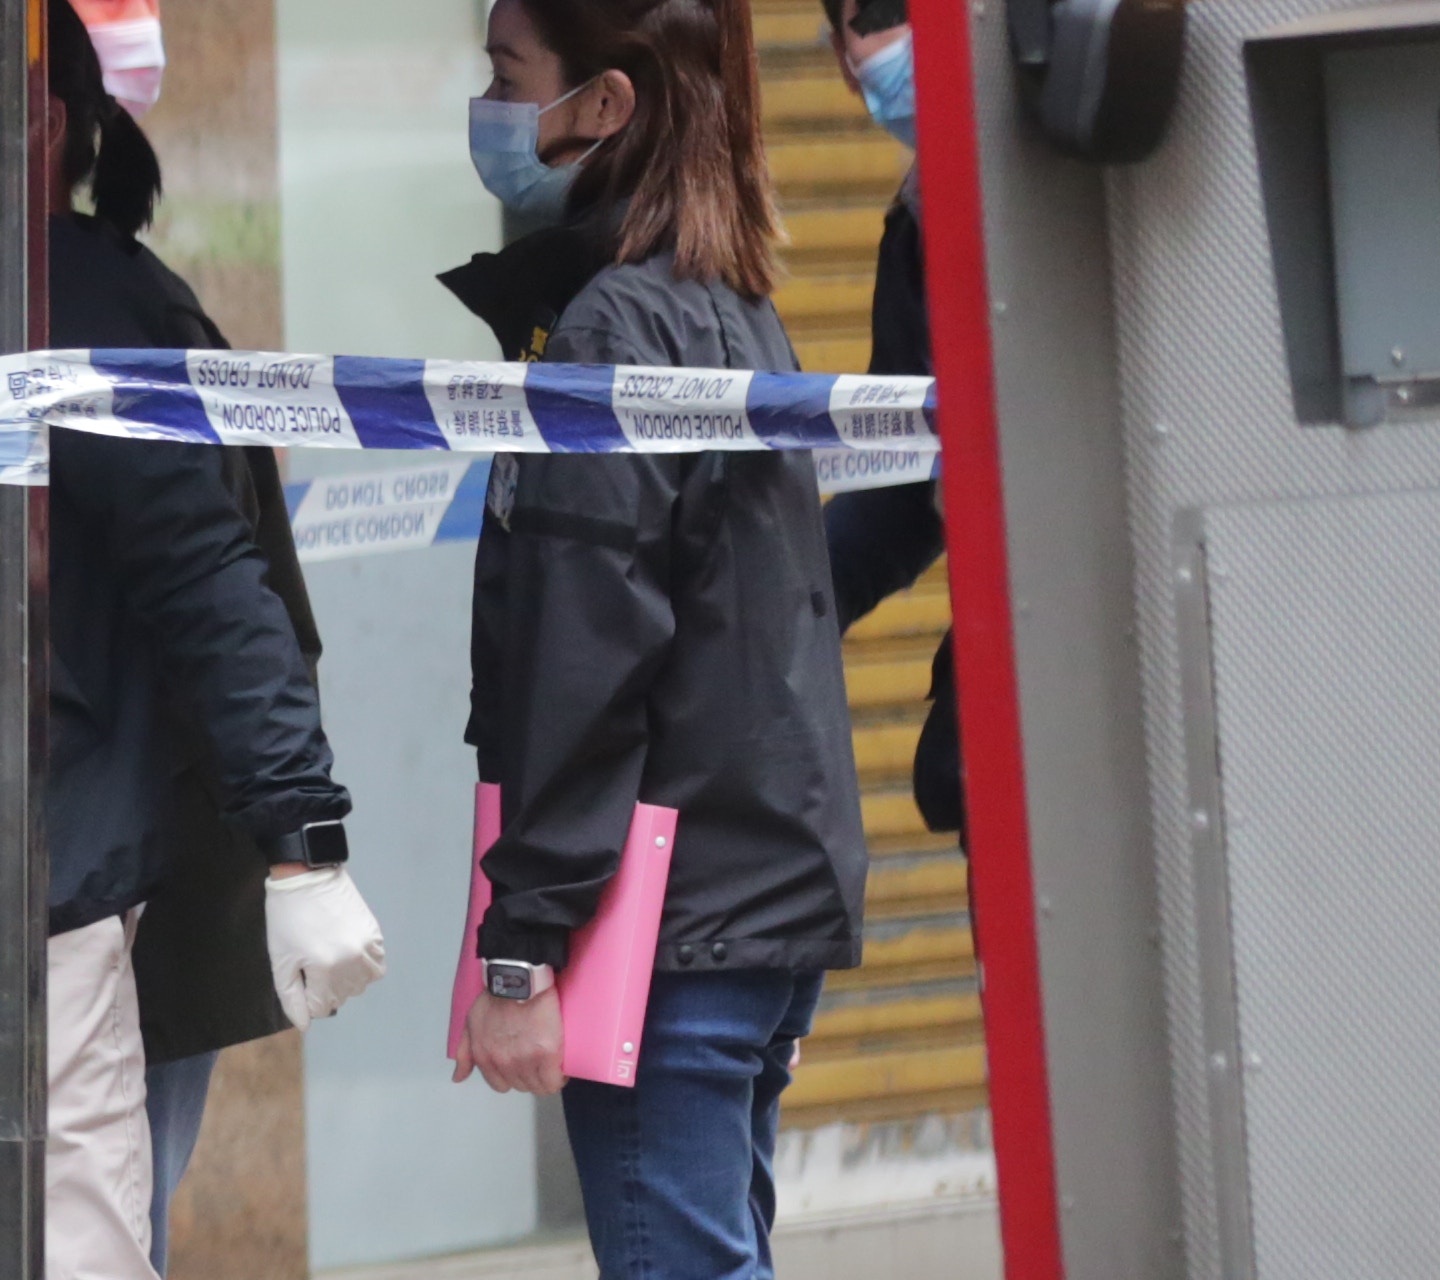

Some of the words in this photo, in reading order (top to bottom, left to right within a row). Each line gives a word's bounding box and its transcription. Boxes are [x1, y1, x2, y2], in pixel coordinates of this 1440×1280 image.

[197, 359, 251, 387] CROSS
[619, 375, 675, 400] CROSS
[288, 405, 342, 435] POLICE
[693, 414, 745, 441] POLICE
